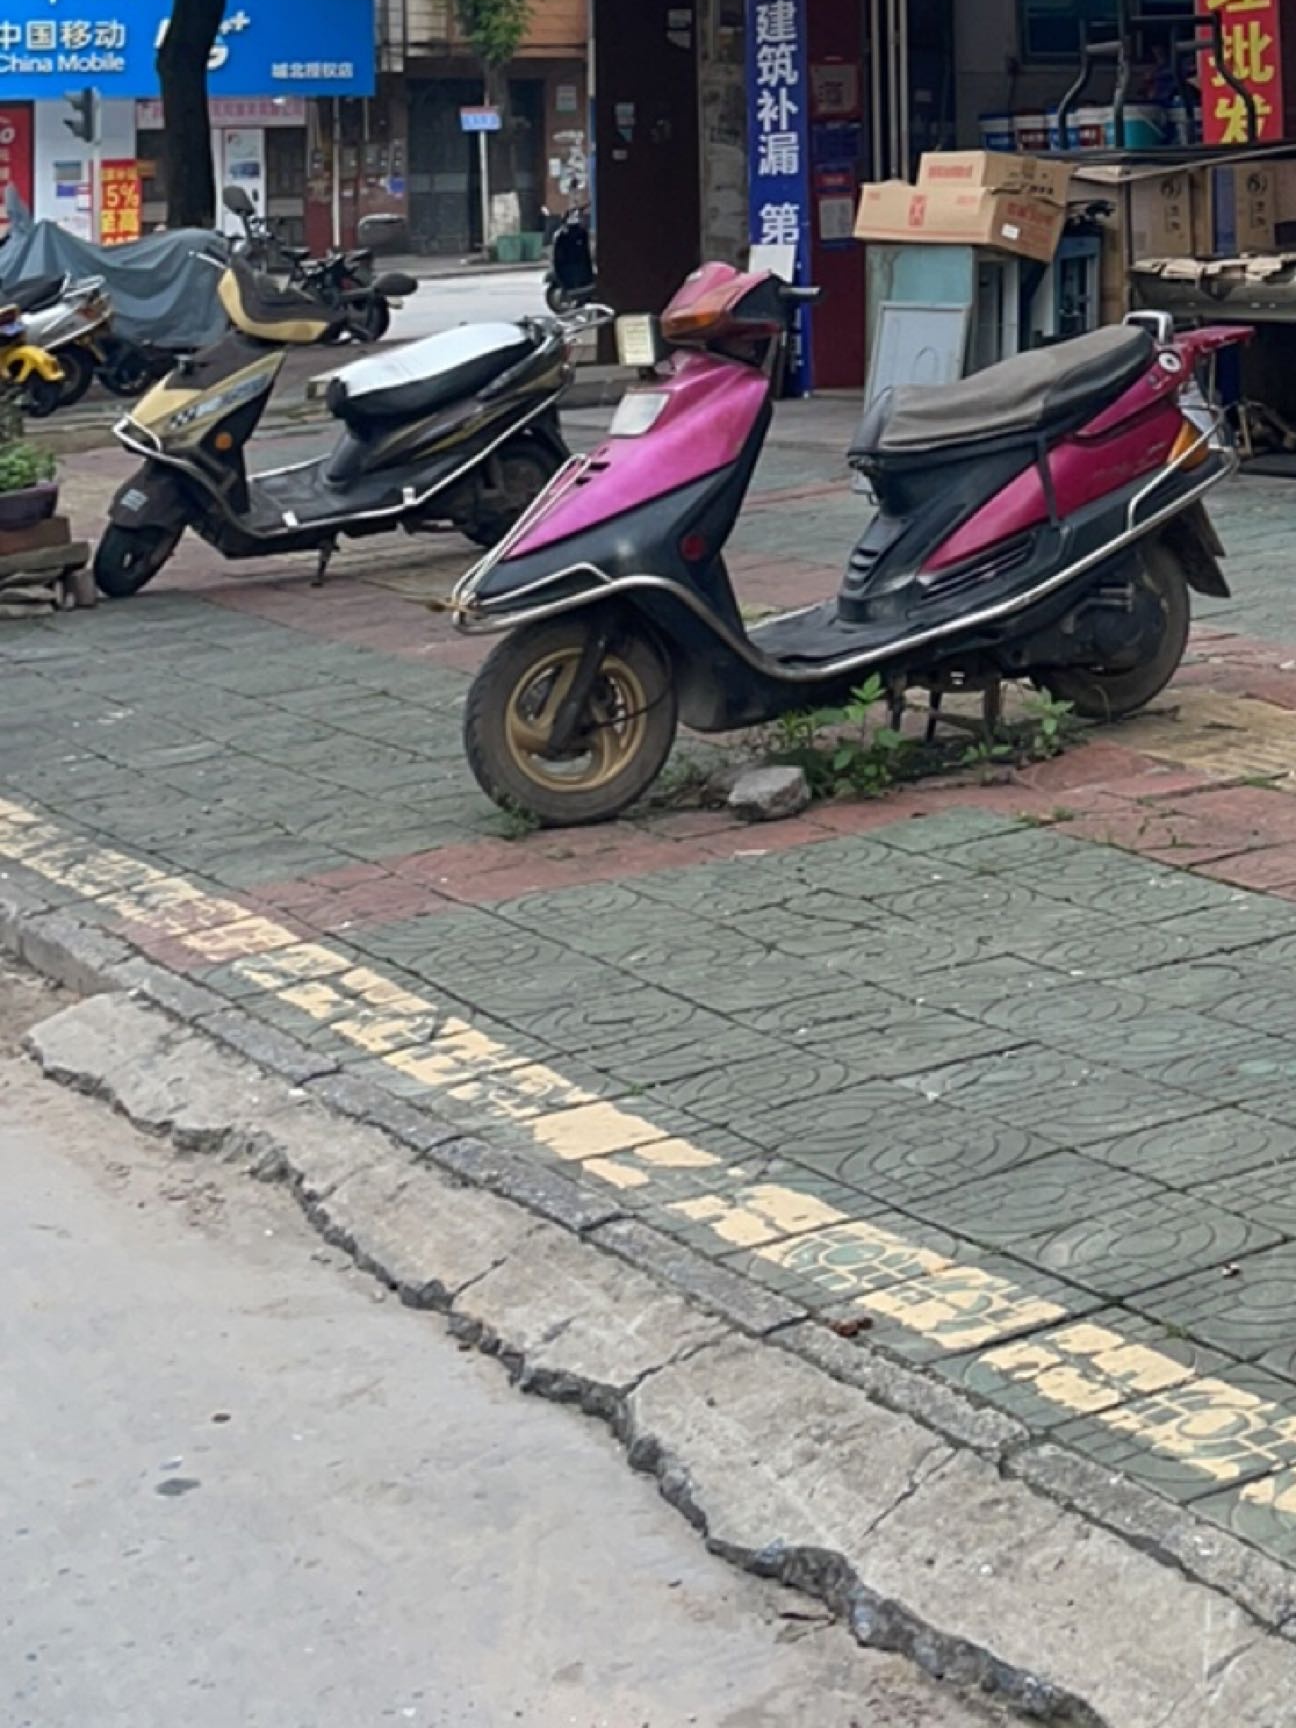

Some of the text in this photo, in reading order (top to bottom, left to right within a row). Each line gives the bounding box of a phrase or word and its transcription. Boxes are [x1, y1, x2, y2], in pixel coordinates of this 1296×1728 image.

[0, 19, 126, 50] 中国移动
[56, 53, 126, 73] Mobile
